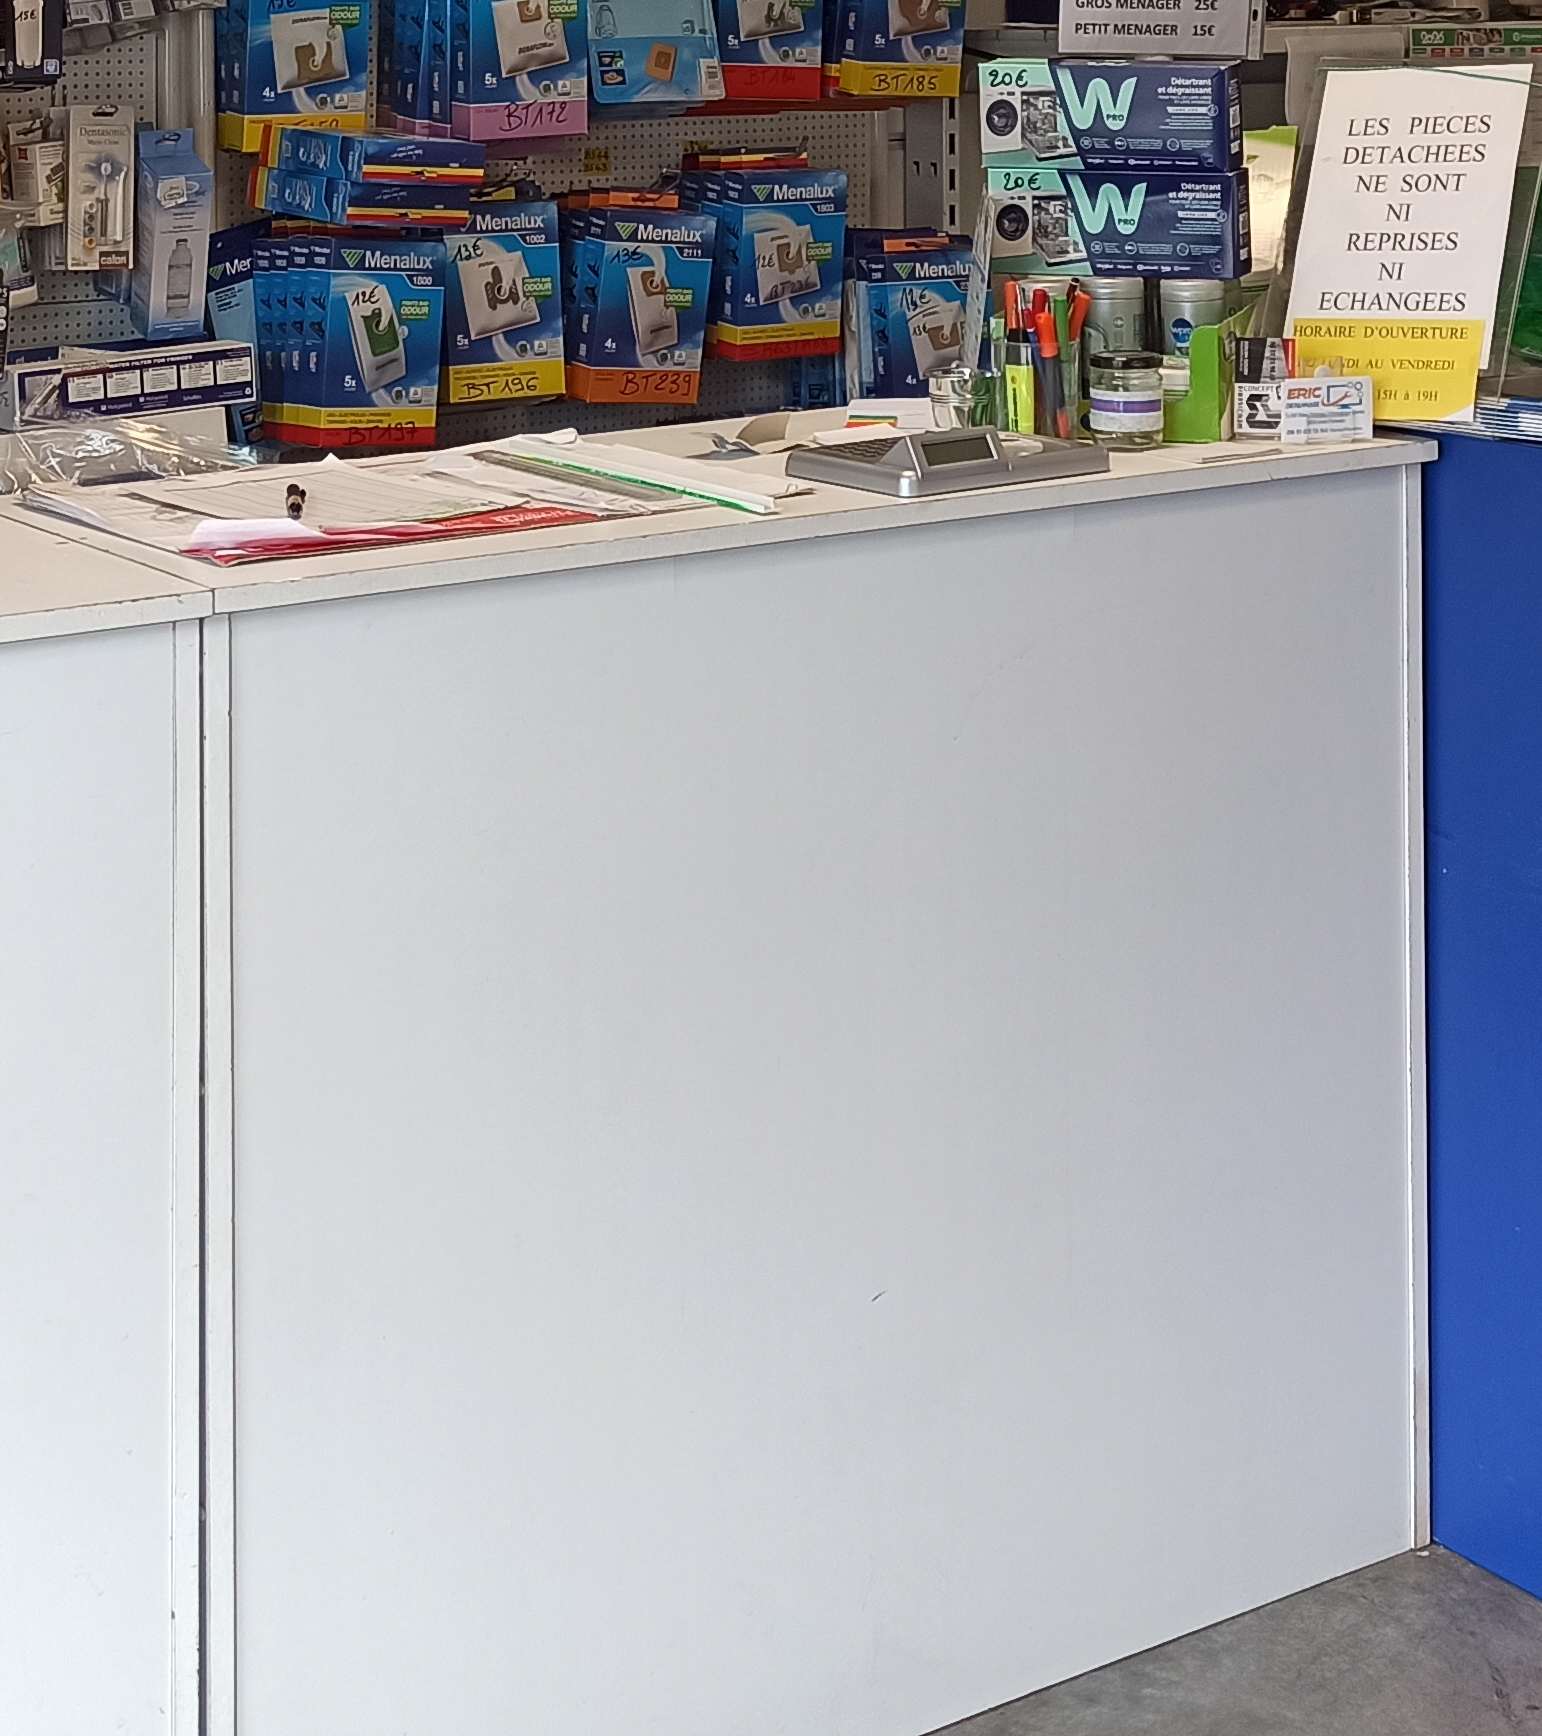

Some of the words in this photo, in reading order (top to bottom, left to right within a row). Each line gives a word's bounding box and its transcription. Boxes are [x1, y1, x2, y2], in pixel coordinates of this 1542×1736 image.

[1195, 0, 1218, 11] 25€
[1075, 23, 1110, 34] PETIT
[1113, 24, 1178, 36] MENAGER
[1192, 25, 1215, 36] 15€
[989, 69, 1028, 87] 20€
[1171, 77, 1211, 86] Détartrant
[1166, 86, 1212, 95] dégraissant
[1106, 114, 1124, 122] PRO
[1347, 117, 1390, 136] LES
[1409, 115, 1491, 134] PIECES
[1343, 144, 1486, 164] DETACHEES
[774, 182, 834, 200] Menalux
[1355, 175, 1388, 192] NE
[1401, 174, 1467, 192] SONT
[1386, 204, 1413, 222] NI
[1347, 232, 1459, 251] REPRISES
[364, 249, 433, 270] Menalux
[1377, 262, 1404, 280] NI
[1318, 292, 1467, 312] ECHANGEES
[1293, 326, 1356, 338] HORAIRE
[1364, 326, 1468, 339] D'OUVERTURE
[1367, 359, 1384, 369] AU
[1390, 359, 1455, 370] VENDREDI
[1287, 387, 1322, 399] ERIC
[1404, 392, 1410, 400] à
[1416, 389, 1438, 401] 19H
